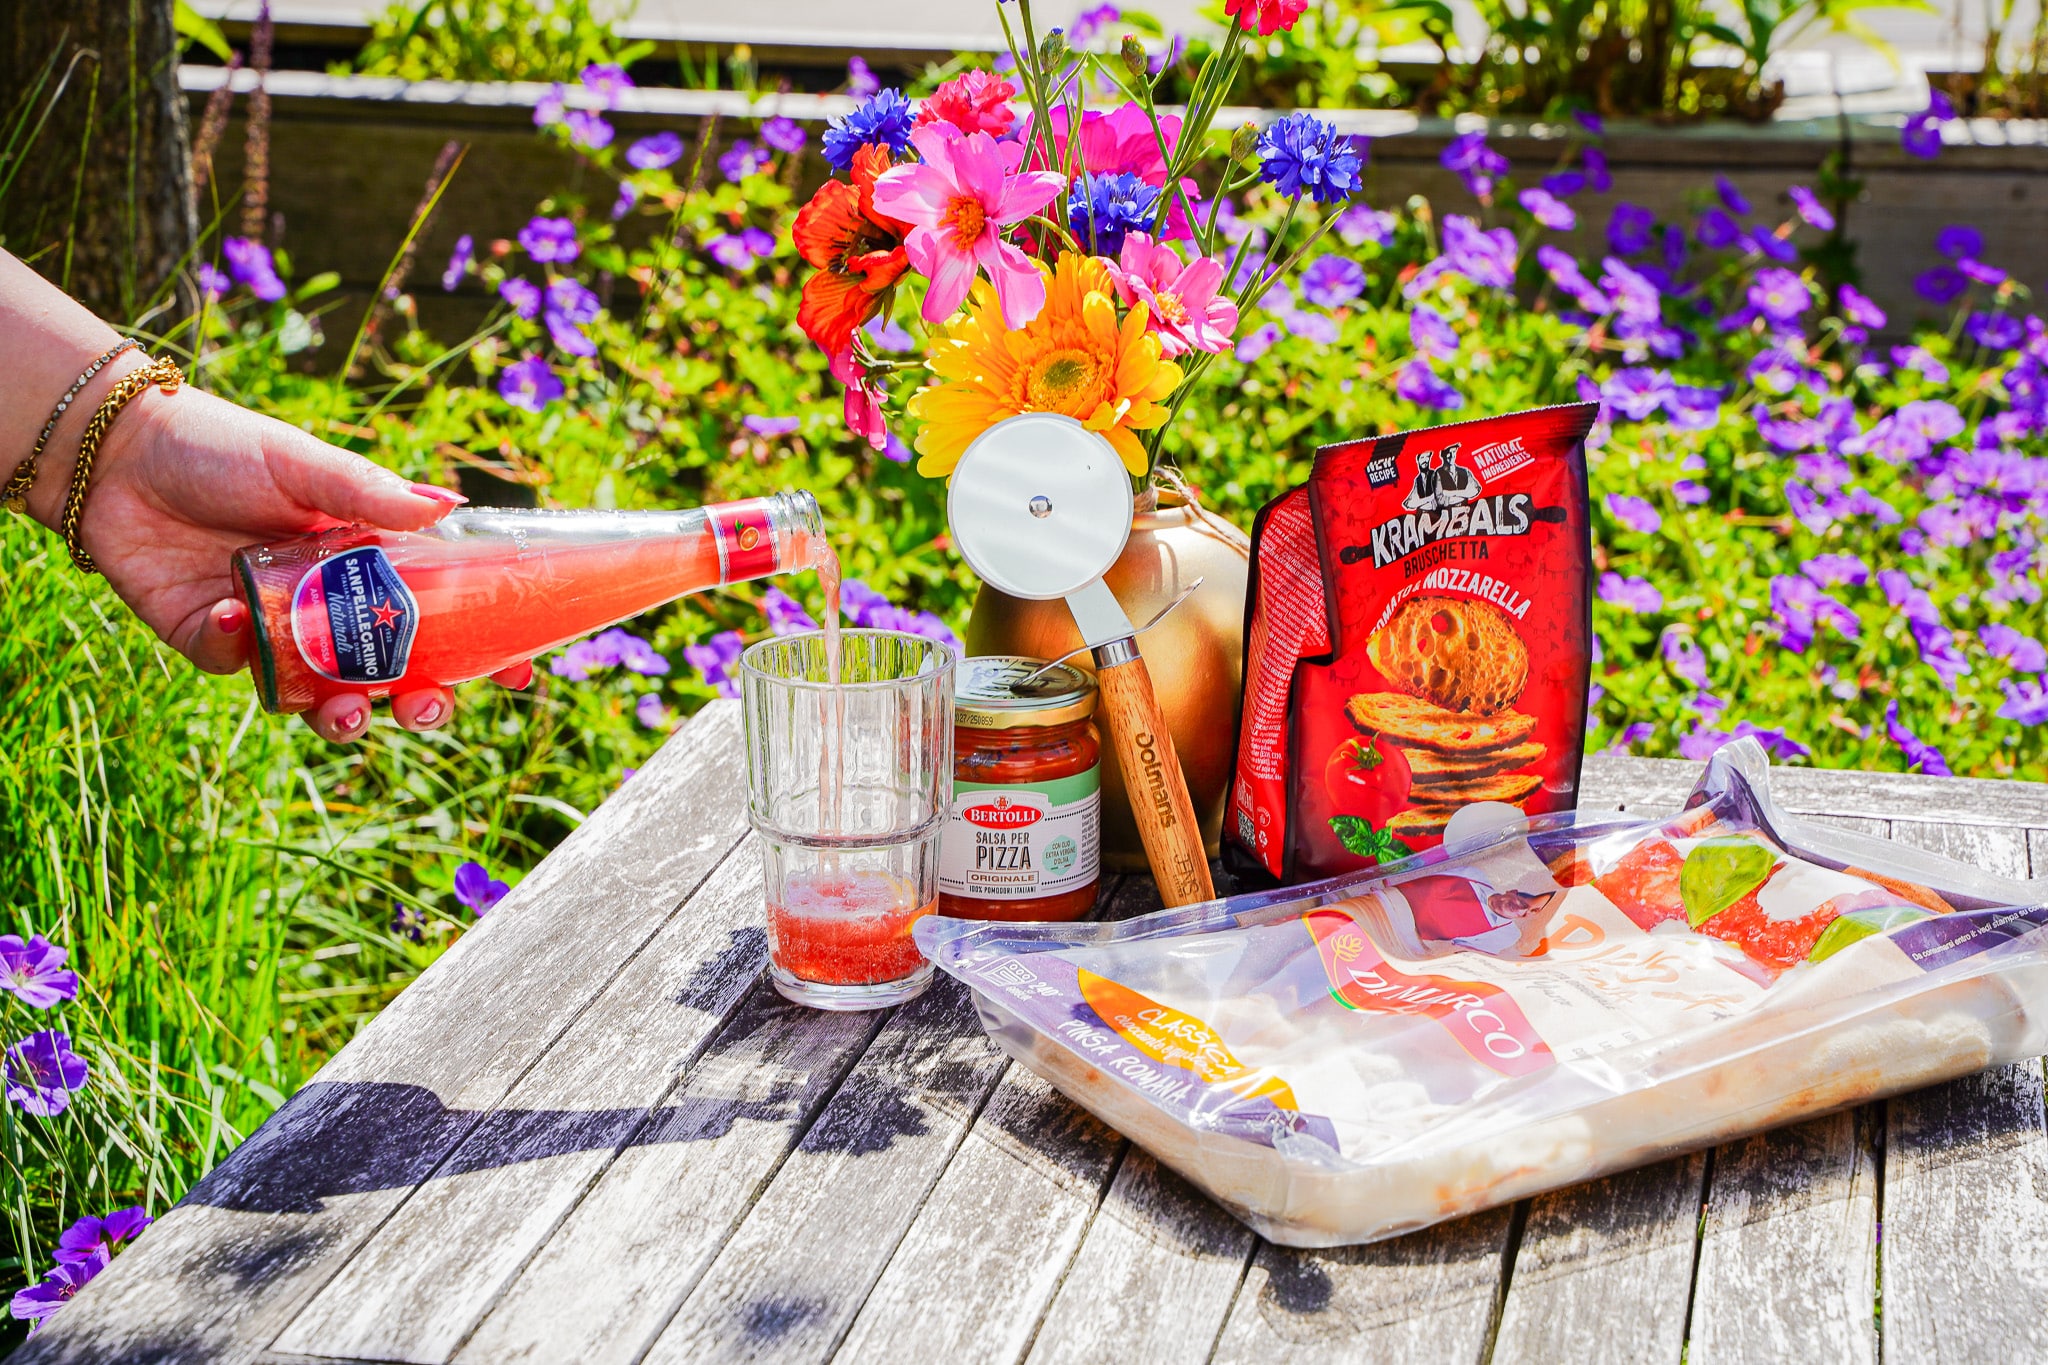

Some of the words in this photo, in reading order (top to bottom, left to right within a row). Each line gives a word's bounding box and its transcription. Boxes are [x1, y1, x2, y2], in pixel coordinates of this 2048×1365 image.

[1367, 456, 1395, 473] NEW
[1473, 438, 1524, 469] NATURAL
[1481, 451, 1532, 481] INGREDIENTS
[1369, 467, 1397, 484] RECIPE
[1371, 494, 1530, 569] KRAMBALS
[1403, 541, 1489, 578] BRUSCHETTA
[376, 585, 385, 602] DAL
[1422, 568, 1533, 621] MOZZARELLA
[326, 591, 353, 654] Naturali
[340, 573, 352, 601] ITALIAN
[346, 600, 359, 640] SPARKLING
[353, 641, 363, 666] DRINKS
[345, 558, 379, 677] SANPELLEGRINO
[318, 635, 332, 663] ROSSA
[955, 711, 994, 726] 027/250859
[1135, 731, 1177, 830] Dolmans
[970, 808, 1036, 823] BERTOLLI
[975, 831, 1006, 845] SALSA
[1011, 831, 1030, 844] PER
[1045, 850, 1060, 859] EXTRA
[1059, 846, 1076, 857] VERGINE
[1051, 841, 1061, 850] CON
[1061, 840, 1071, 849] OLIO
[975, 845, 1031, 871] PIZZA
[969, 885, 983, 894] 100%
[984, 885, 1013, 895] POMODORI
[1014, 885, 1037, 895] ITALIANI
[971, 874, 1035, 883] ORIGINALE
[1911, 952, 1923, 961] Da
[1922, 941, 1956, 957] consumarsi
[1954, 933, 1972, 947] entro
[1970, 931, 1978, 940] il:
[1977, 923, 1993, 936] vedi
[1992, 912, 2020, 929] stampa
[2018, 908, 2029, 917] su
[1137, 1008, 1241, 1075] CLASSICA
[1057, 1018, 1122, 1057] PINSA
[1108, 1055, 1194, 1103] ROMANA
